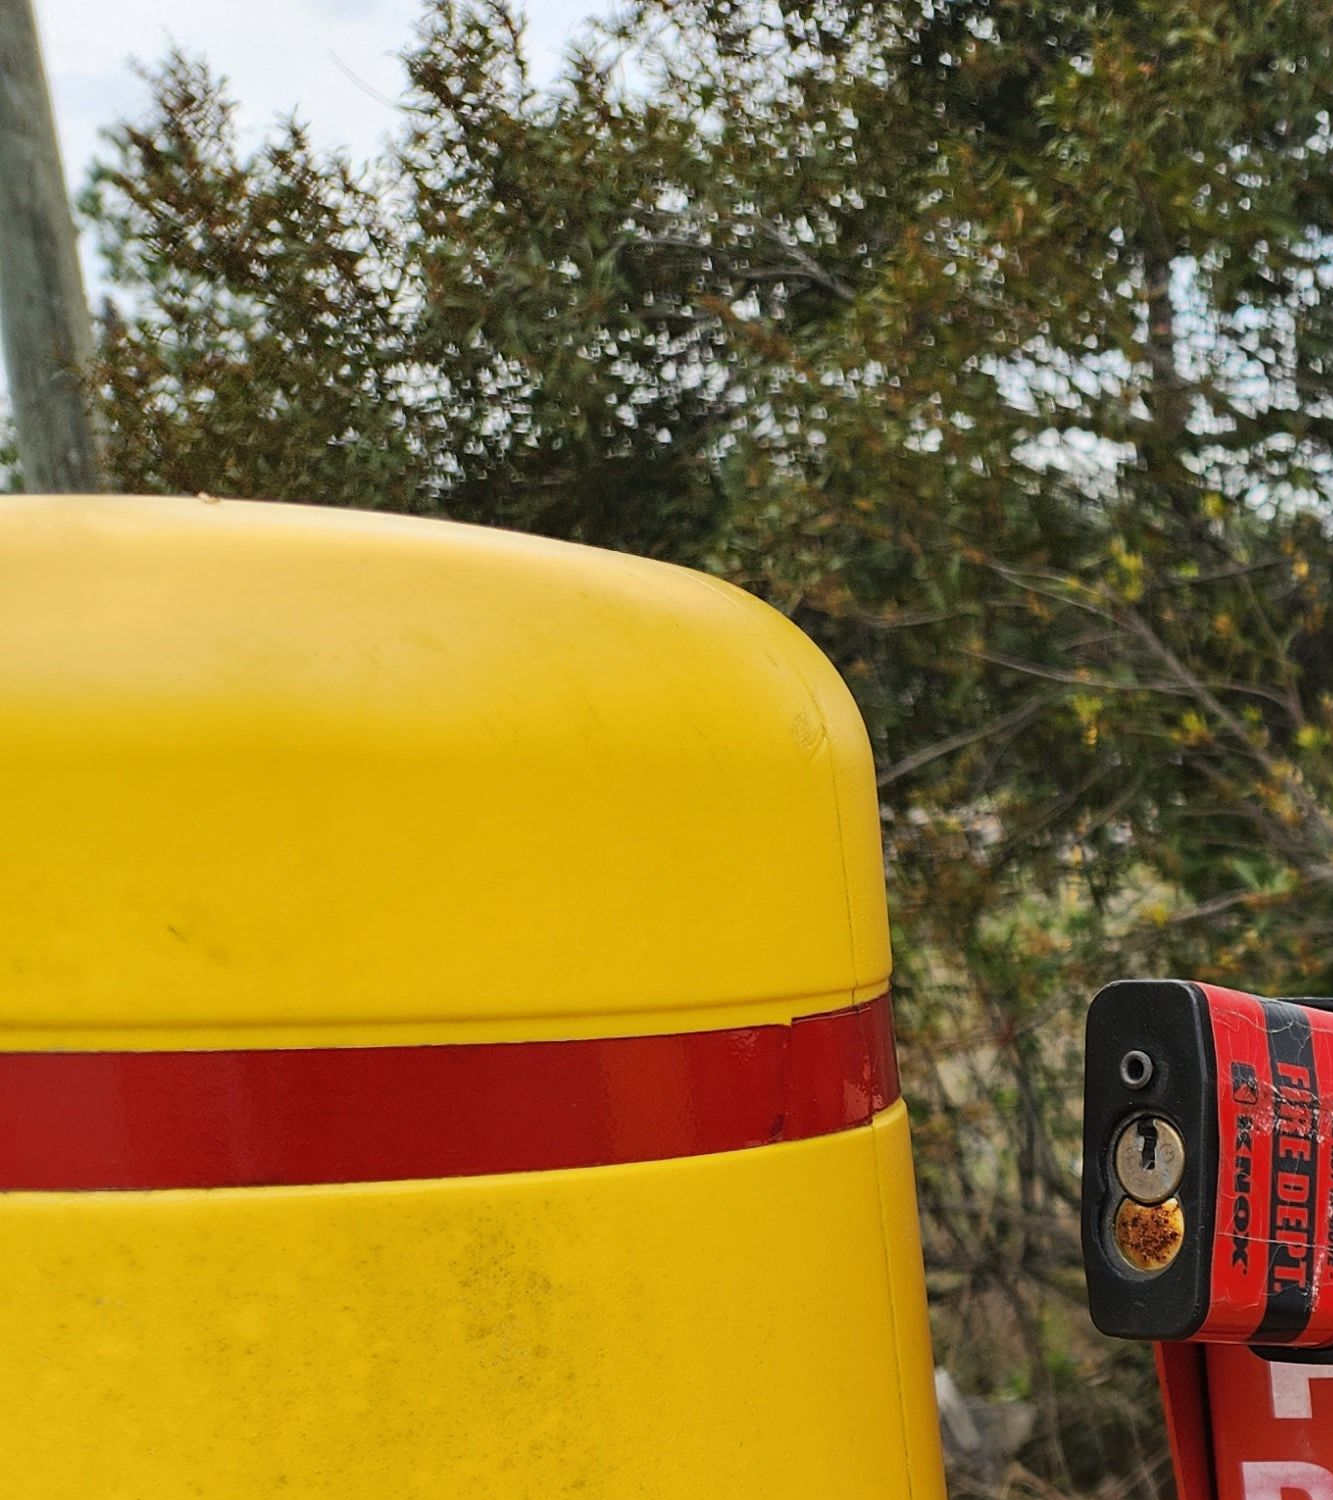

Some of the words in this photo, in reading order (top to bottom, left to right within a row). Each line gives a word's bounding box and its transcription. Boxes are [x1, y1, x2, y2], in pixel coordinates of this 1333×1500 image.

[1276, 1061, 1313, 1161] FIRE
[1233, 1115, 1253, 1268] KNOX
[1273, 1171, 1312, 1293] DEPT.
